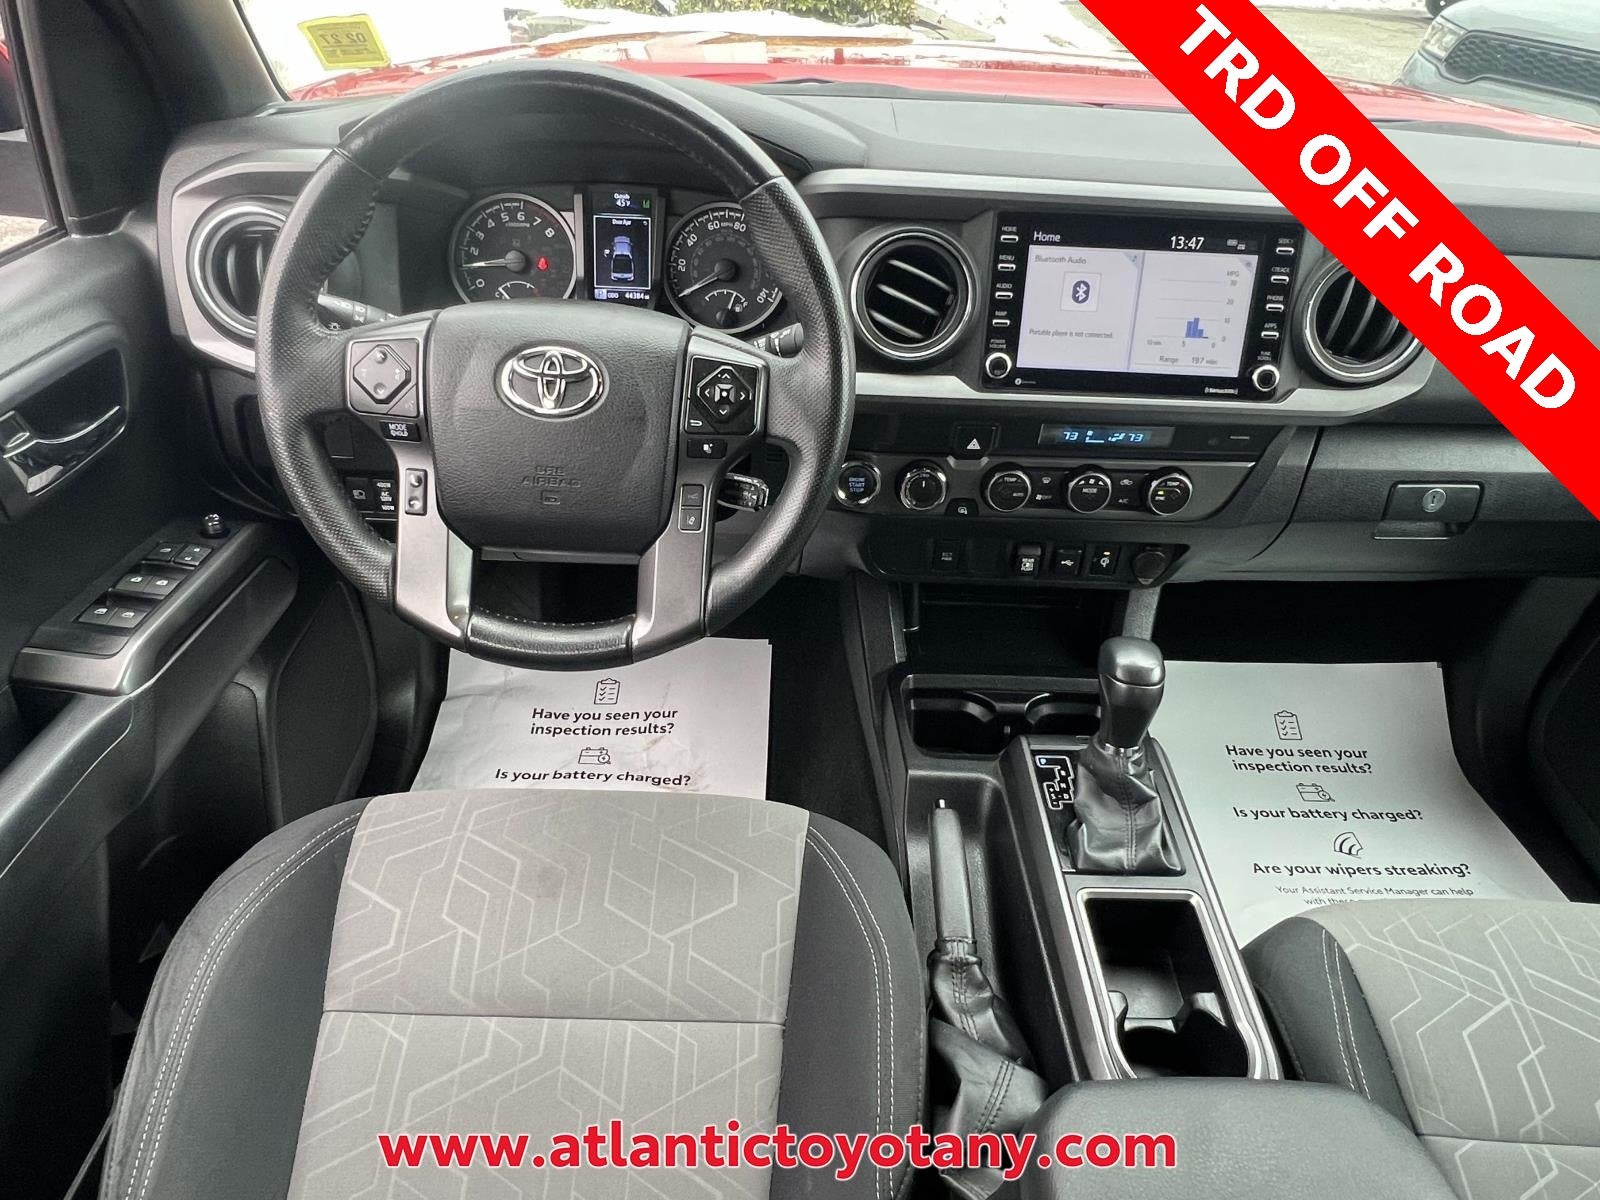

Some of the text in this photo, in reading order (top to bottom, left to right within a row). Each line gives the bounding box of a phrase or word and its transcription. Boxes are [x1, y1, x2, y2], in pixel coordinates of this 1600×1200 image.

[500, 212, 510, 222] 5
[516, 211, 526, 221] 6
[532, 216, 542, 226] 7
[487, 218, 496, 228] 4
[707, 220, 720, 231] 60
[733, 221, 747, 232] 80
[475, 231, 485, 241] 3
[544, 227, 555, 238] 8
[1033, 231, 1061, 242] Home
[686, 233, 698, 247] 40
[1170, 236, 1204, 250] 13:47
[469, 247, 479, 256] 2
[677, 258, 686, 272] 20
[1034, 255, 1087, 265] Bluetooth Audio
[475, 279, 485, 288] 0
[388, 423, 407, 431] MODE
[1063, 431, 1078, 440] 73
[1128, 433, 1143, 442] 73
[532, 707, 678, 723] Have you seen your
[530, 722, 675, 737] inspection results?
[1225, 745, 1368, 761] Have you seen your
[1233, 760, 1372, 774] inspection results?
[495, 768, 691, 787] Is your battery charged?
[1233, 806, 1423, 823] Is your battery charged?
[1253, 863, 1472, 878] Are your wipers streaking?
[1275, 886, 1298, 894] Your
[1301, 886, 1345, 895] Assistant
[1347, 886, 1383, 895] Service
[1384, 887, 1428, 897] Manager
[1450, 887, 1474, 896] help
[1304, 898, 1327, 906] with
